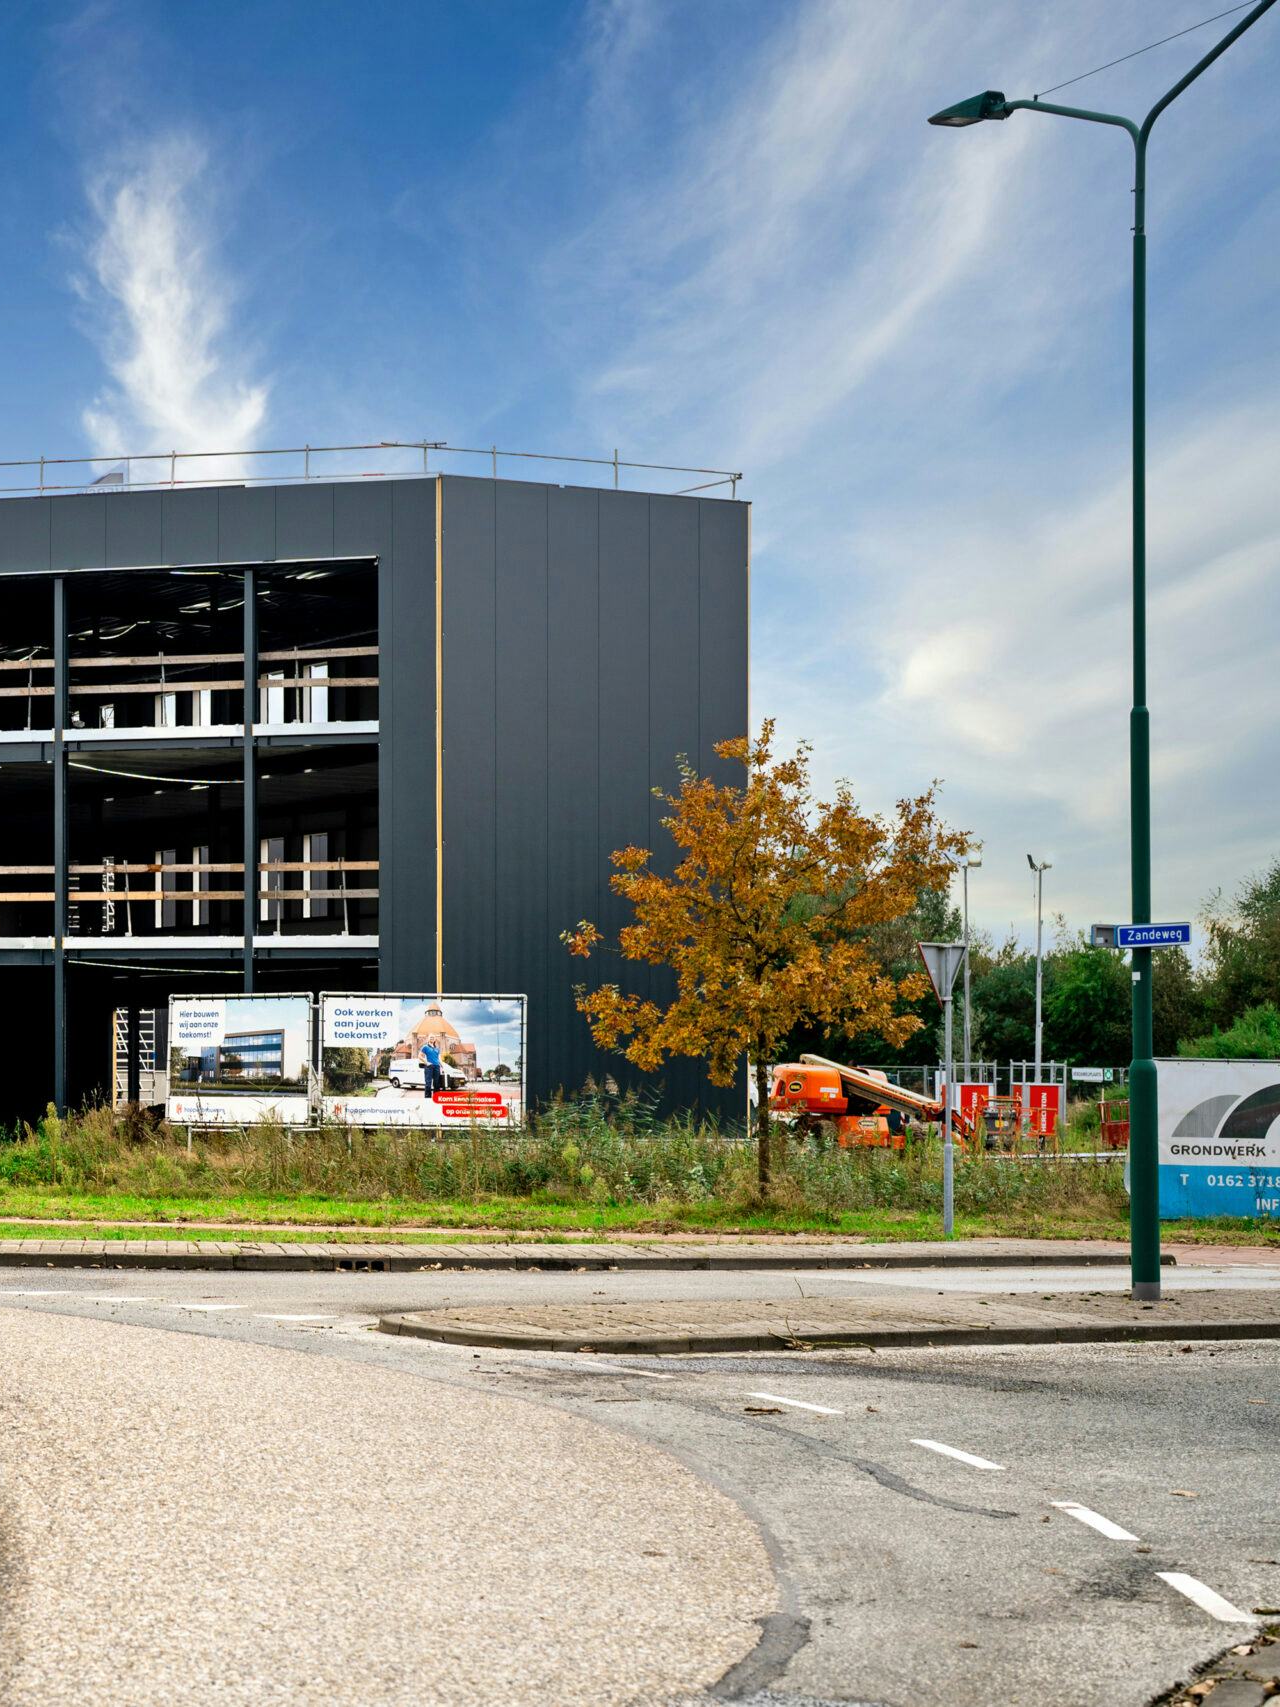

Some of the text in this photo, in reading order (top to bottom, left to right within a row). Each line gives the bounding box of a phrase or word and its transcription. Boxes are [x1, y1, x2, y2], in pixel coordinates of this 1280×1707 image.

[1127, 929, 1182, 941] Zandeweg
[179, 1010, 219, 1018] Hier bouwen
[334, 1008, 393, 1017] Ook werken
[179, 1020, 189, 1030] wij
[355, 1019, 380, 1030] jouw
[178, 1031, 212, 1039] toekomst!
[334, 1031, 387, 1039] toekomst?
[1170, 1144, 1266, 1157] GRONDWERK
[1179, 1173, 1189, 1186] T
[1207, 1175, 1243, 1187] 0162
[1256, 1198, 1280, 1211] INF
